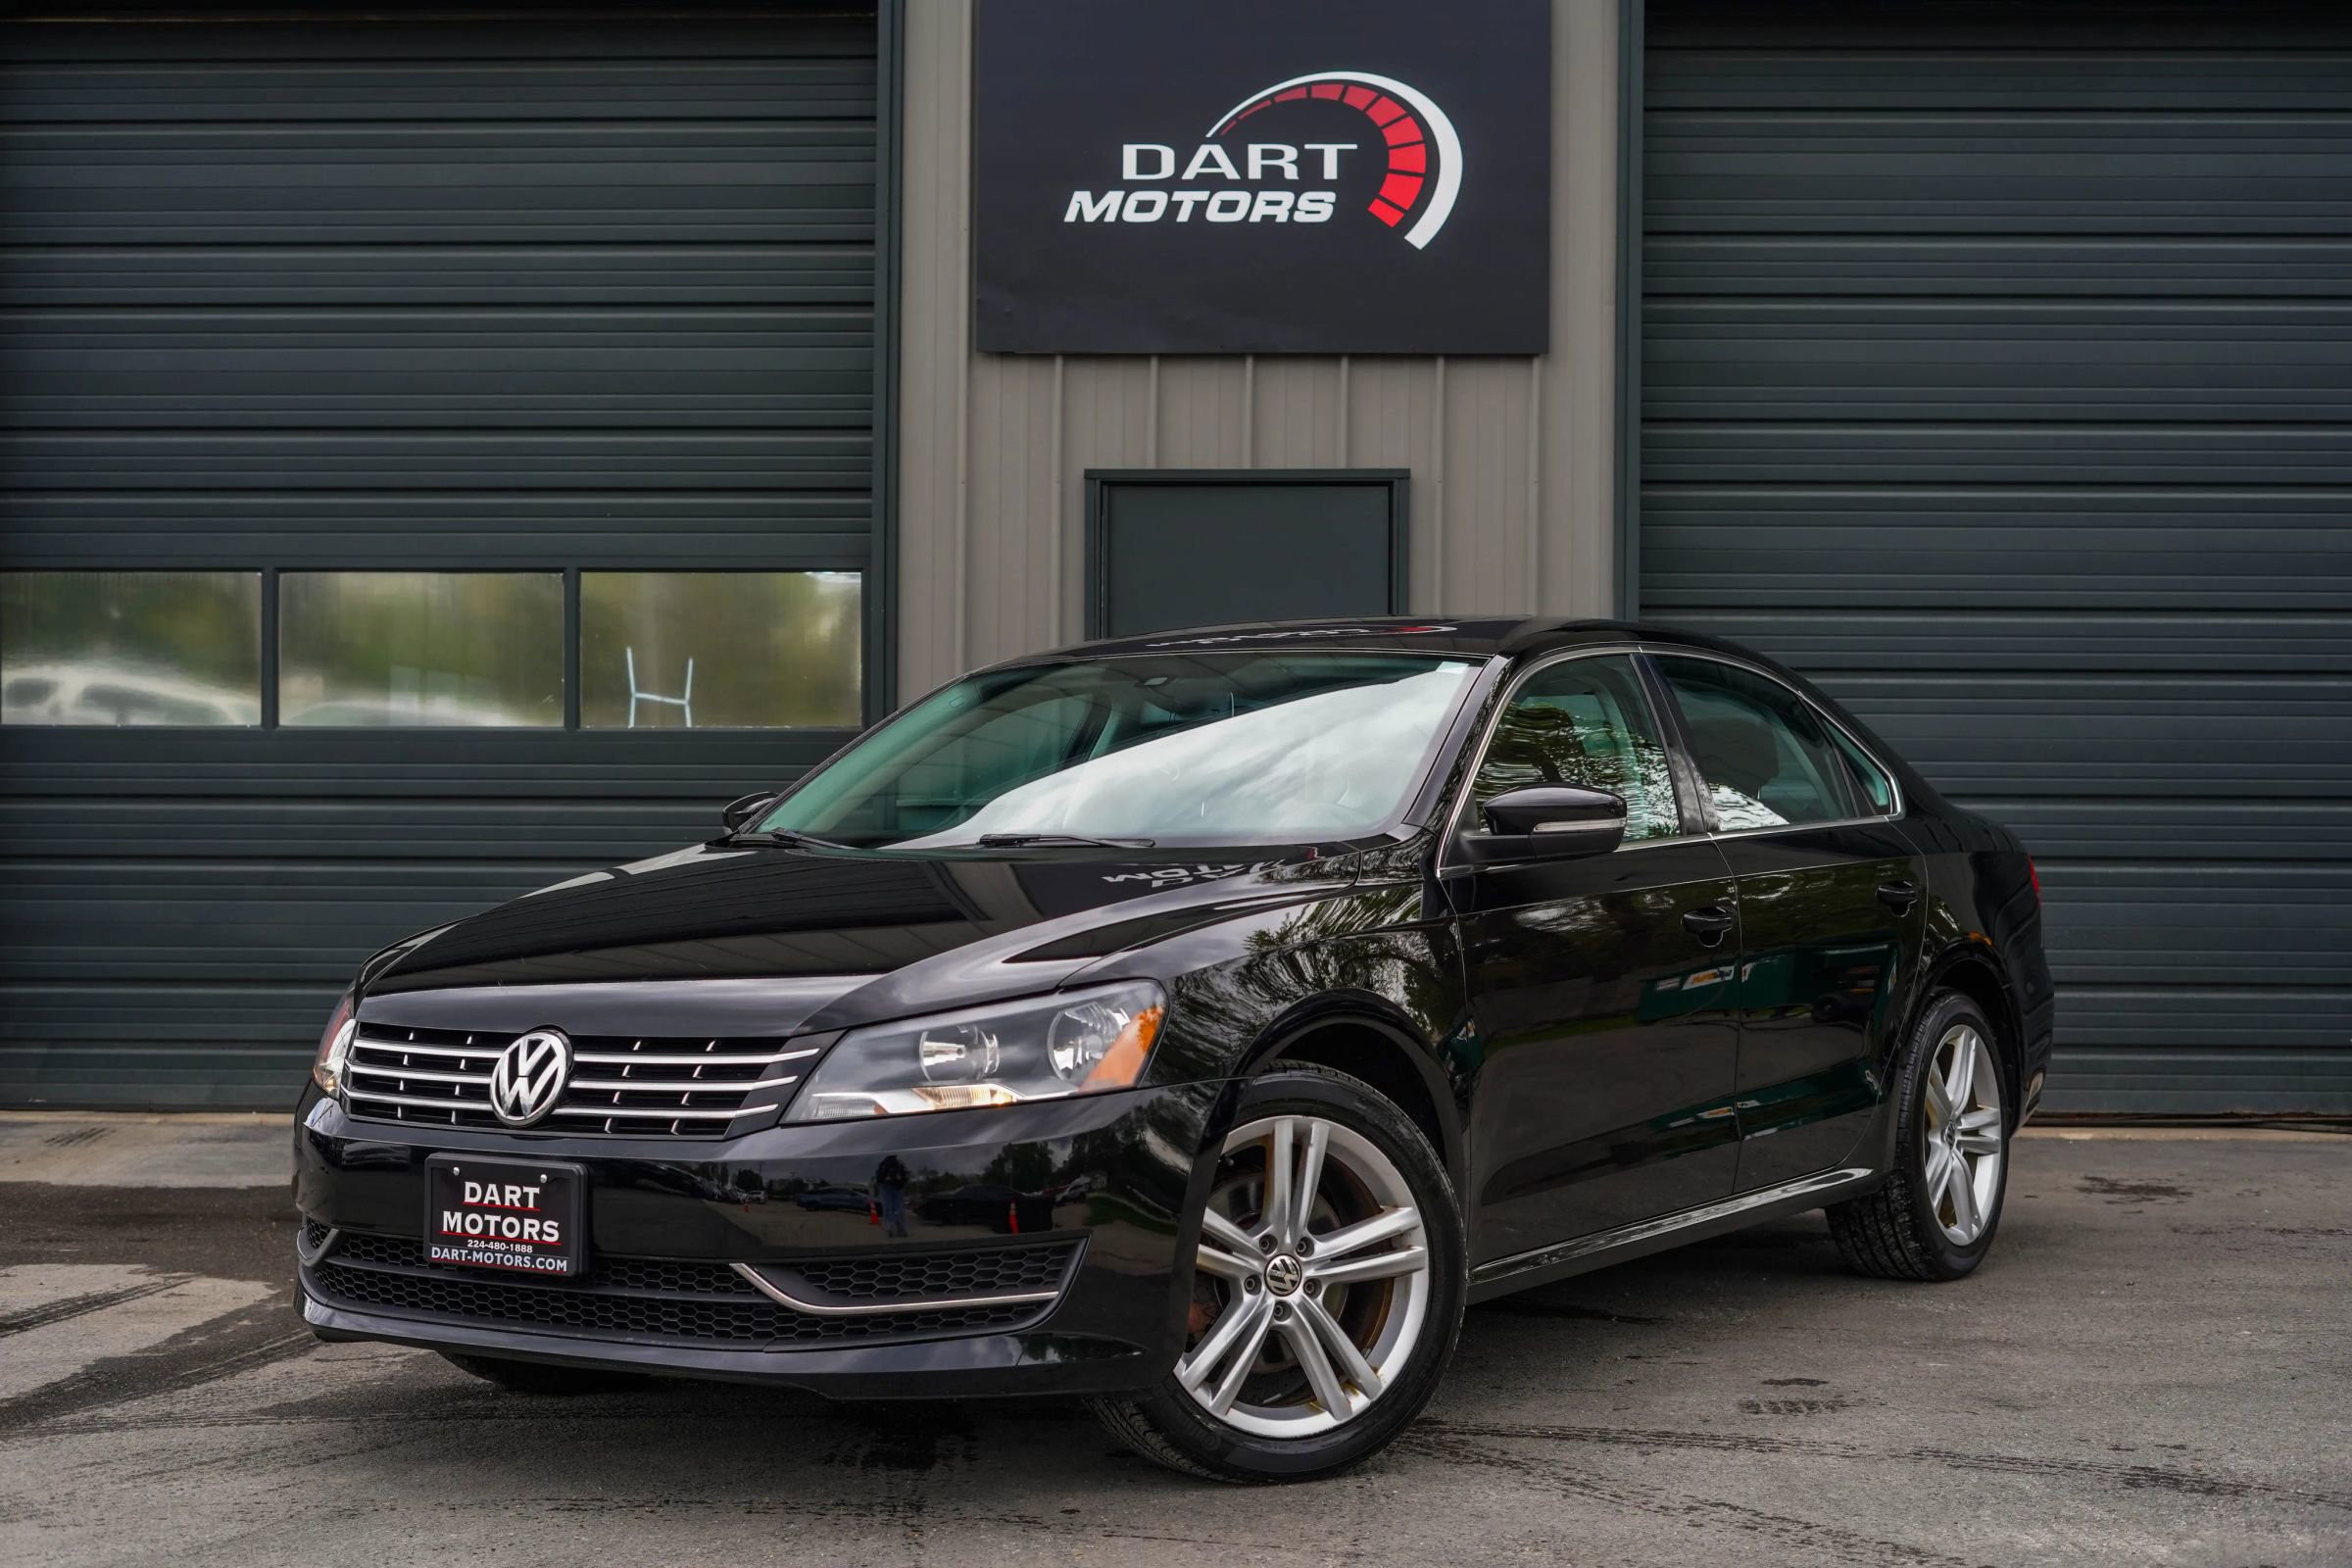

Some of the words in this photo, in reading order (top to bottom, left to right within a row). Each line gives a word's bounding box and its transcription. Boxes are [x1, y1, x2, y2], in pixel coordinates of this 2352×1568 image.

[1122, 143, 1358, 180] DART
[1063, 190, 1337, 222] MOTORS
[464, 1181, 540, 1208] DART
[442, 1210, 560, 1243] MOTORS
[431, 1247, 567, 1272] DART-MOTORS.COM
[466, 1239, 533, 1253] 224-480-1888
